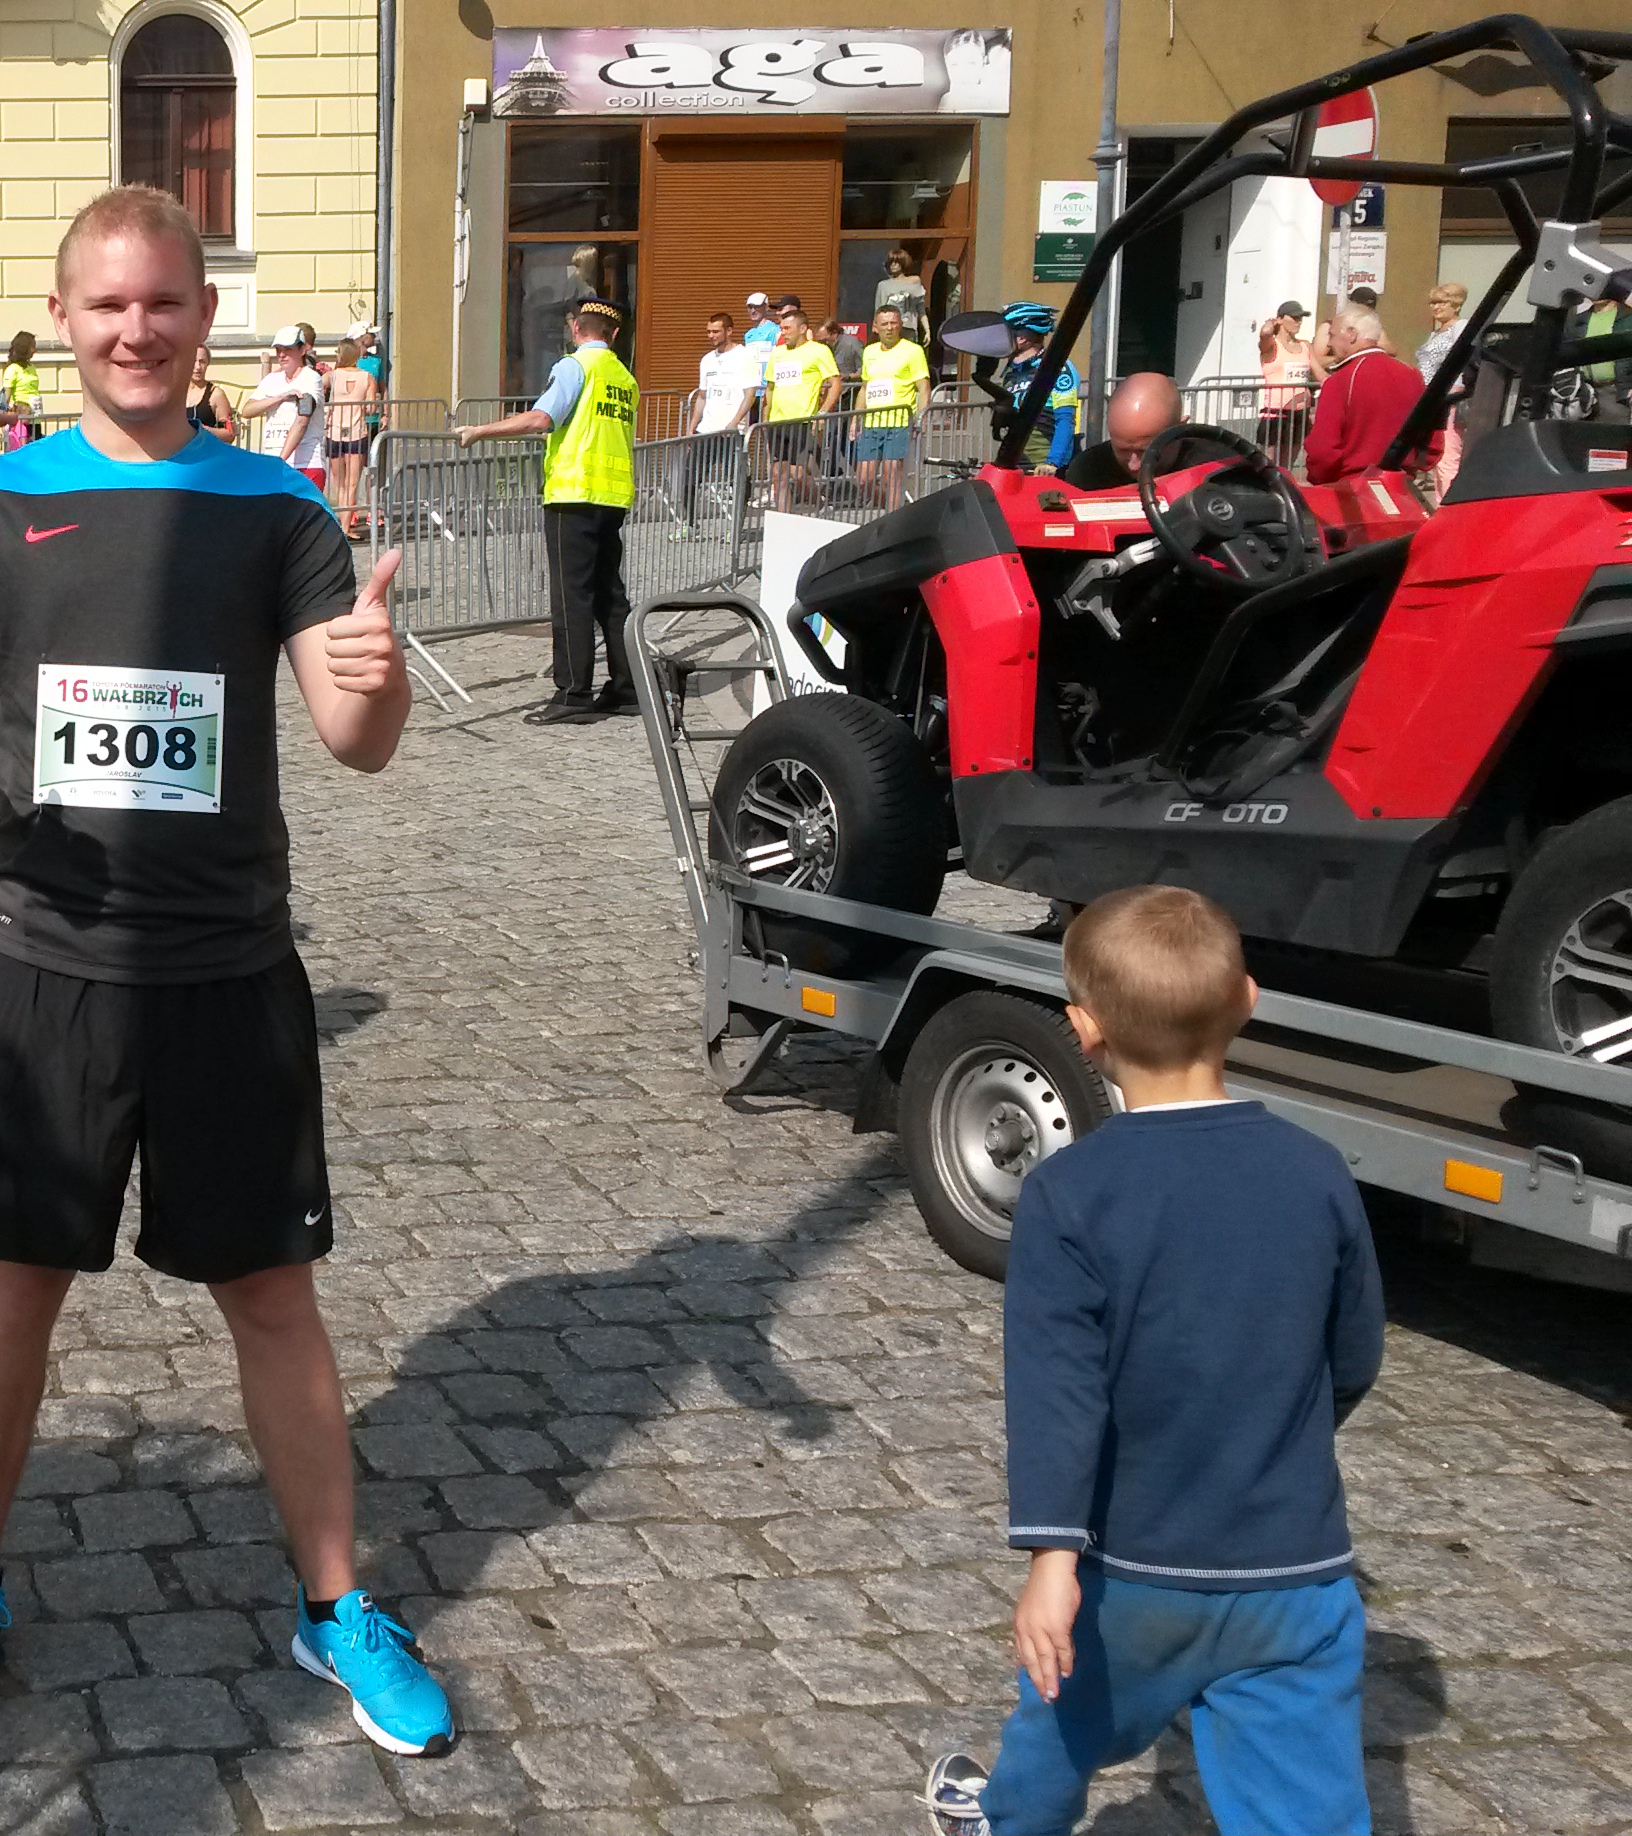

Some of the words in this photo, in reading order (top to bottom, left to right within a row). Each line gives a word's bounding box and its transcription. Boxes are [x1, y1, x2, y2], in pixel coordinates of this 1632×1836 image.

[598, 39, 924, 106] aga
[604, 92, 744, 108] collection
[1053, 203, 1093, 212] PIASTUN
[1354, 199, 1367, 224] 5
[57, 678, 89, 703] 16
[53, 721, 197, 771] 1308
